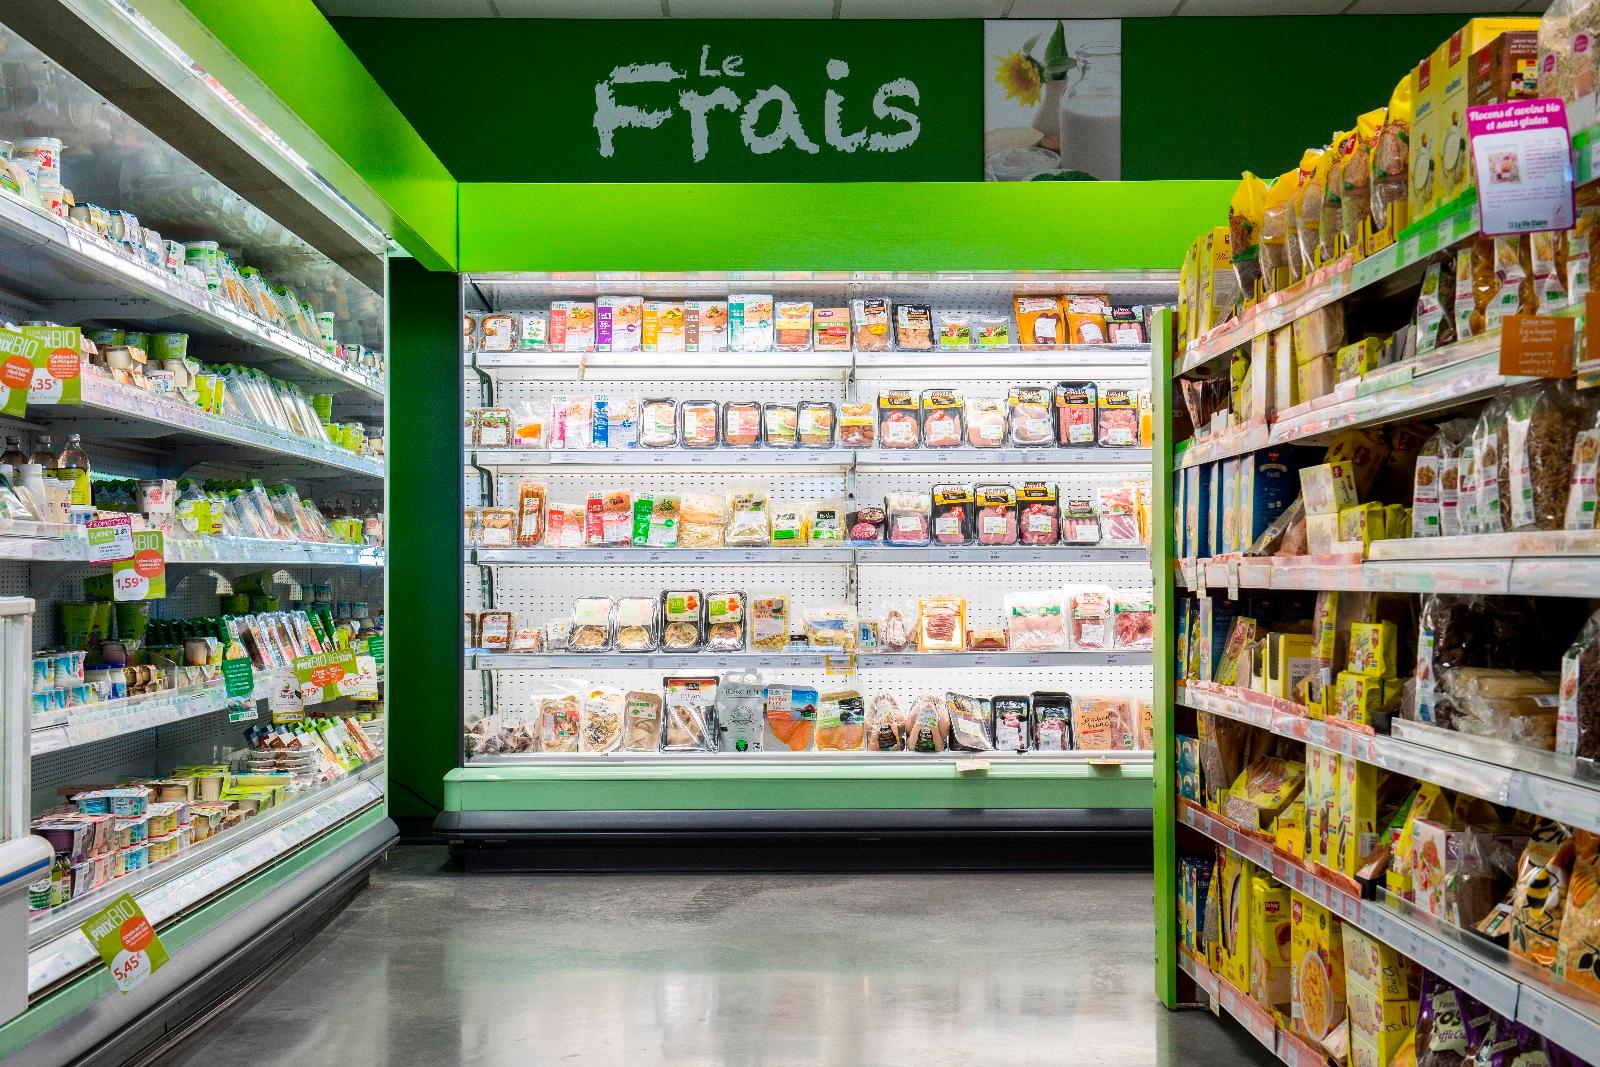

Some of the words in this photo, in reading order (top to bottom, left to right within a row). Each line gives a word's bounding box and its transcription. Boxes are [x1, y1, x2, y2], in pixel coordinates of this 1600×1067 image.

[699, 44, 745, 77] Le
[593, 59, 921, 163] Frais
[1469, 110, 1504, 122] Flocons
[1505, 105, 1545, 118] d'avoine
[1545, 103, 1560, 113] bio
[1486, 122, 1495, 131] et
[1496, 119, 1518, 130] sans
[1519, 116, 1549, 129] gluten
